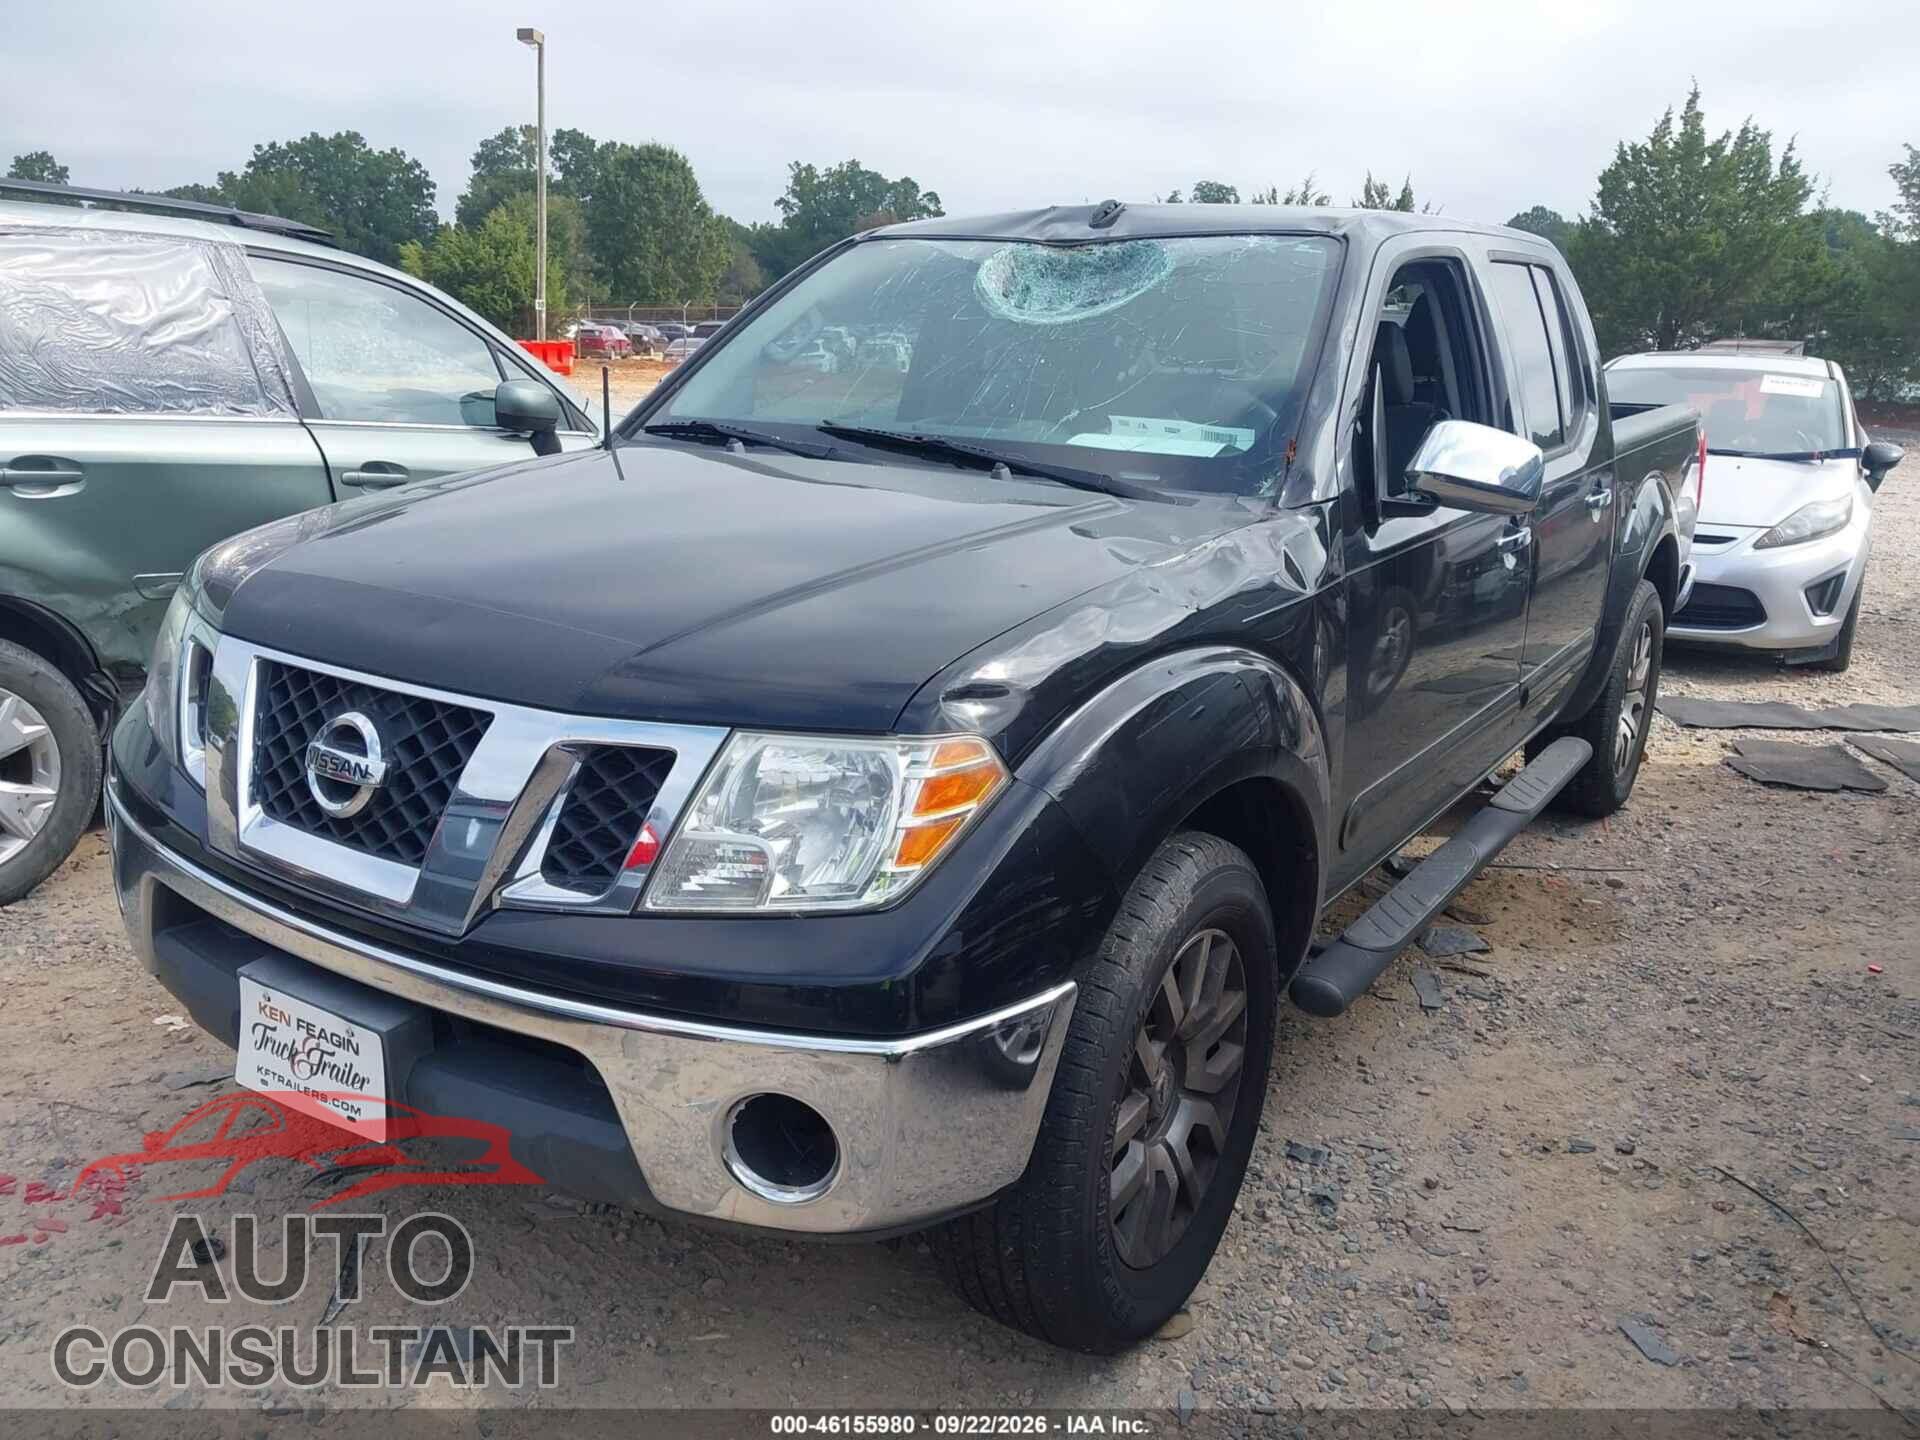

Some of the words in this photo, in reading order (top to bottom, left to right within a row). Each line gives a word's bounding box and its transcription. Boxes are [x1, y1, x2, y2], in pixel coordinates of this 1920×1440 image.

[308, 747, 370, 779] NISSAN
[258, 1002, 291, 1027] KEN
[296, 1018, 360, 1057] FEAGIN
[252, 1022, 298, 1063] Truck
[307, 1047, 370, 1092] Trailer
[257, 1065, 361, 1117] KFTRAILERS.COM
